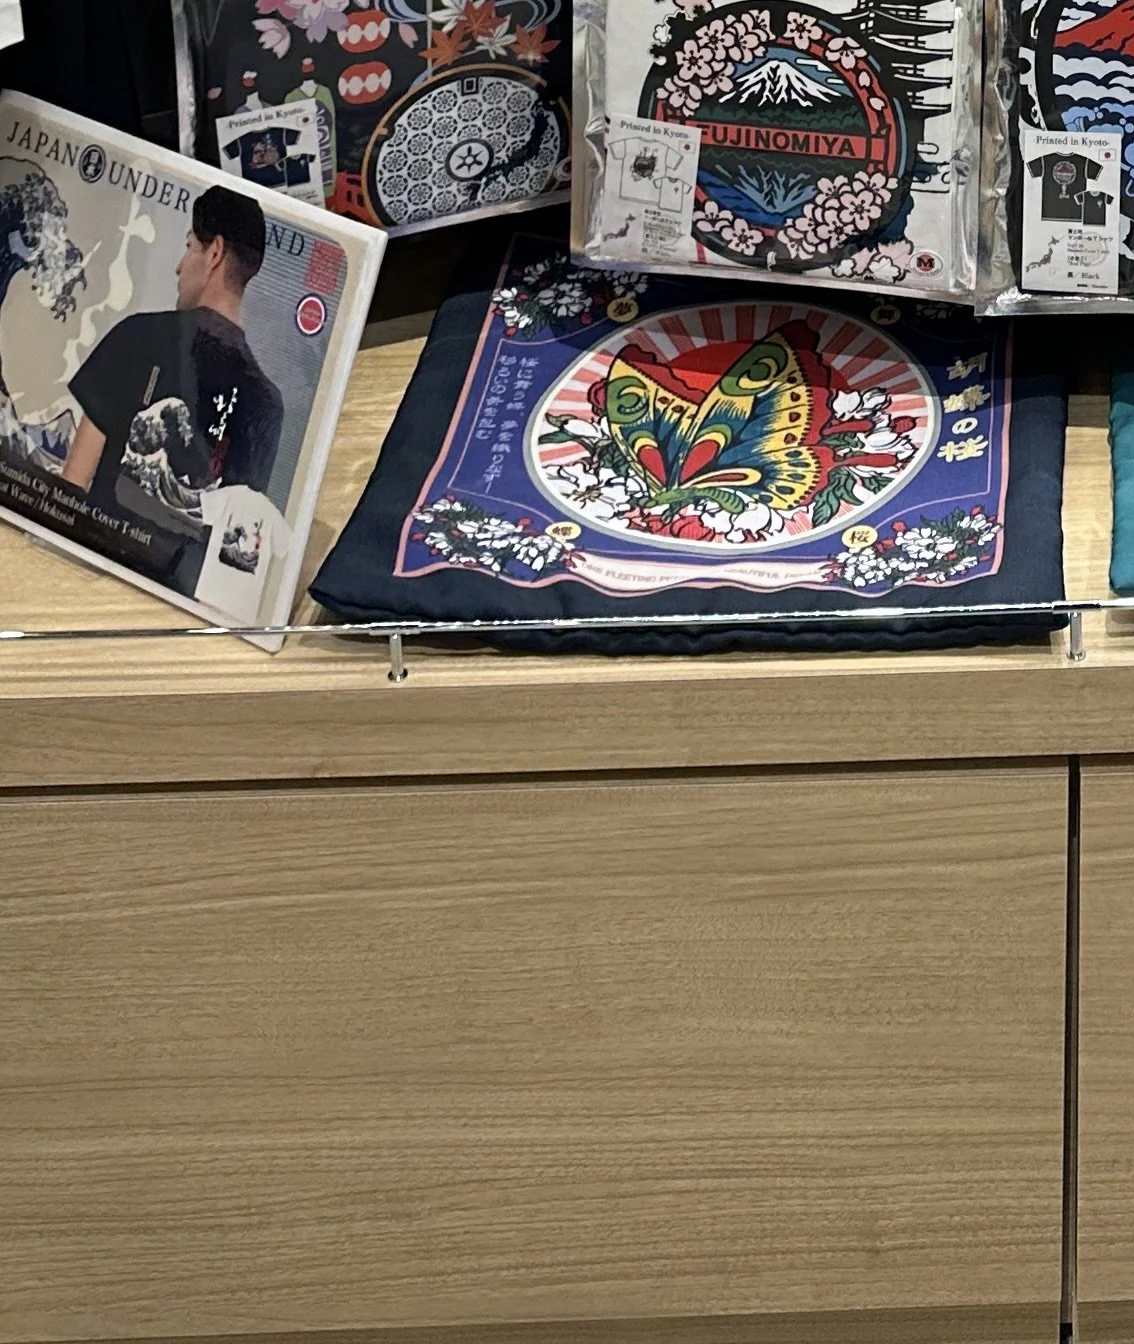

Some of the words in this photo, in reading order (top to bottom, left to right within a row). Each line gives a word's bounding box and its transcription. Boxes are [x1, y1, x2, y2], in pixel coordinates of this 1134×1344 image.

[6, 121, 81, 168] JAPAN
[699, 124, 857, 158] FUJINOMIYA
[31, 479, 51, 496] City
[50, 488, 92, 515] Manhole
[90, 507, 121, 529] Cover
